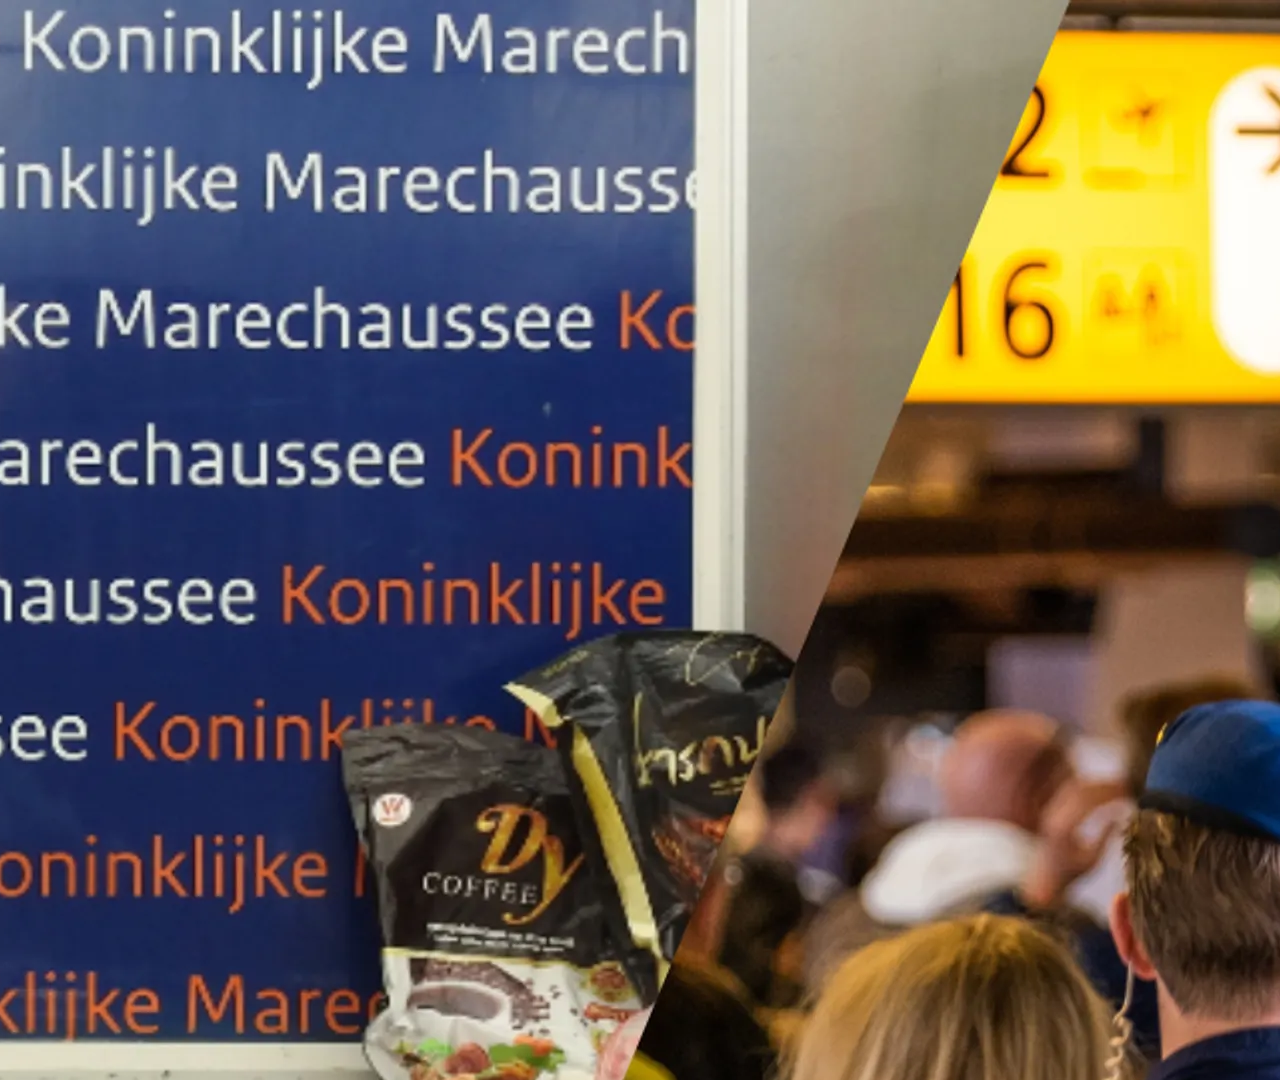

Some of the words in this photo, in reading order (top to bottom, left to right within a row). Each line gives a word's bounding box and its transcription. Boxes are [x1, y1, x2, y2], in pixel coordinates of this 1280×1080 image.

[24, 10, 408, 89] Koninklijke
[434, 11, 689, 74] Marech
[97, 287, 592, 349] Marechaussee
[620, 290, 695, 351] Ko
[952, 261, 1055, 359] 16
[451, 426, 693, 488] Konink
[282, 562, 665, 640] Koninklijke
[422, 871, 538, 906] COFFEE
[476, 803, 585, 926] Dy
